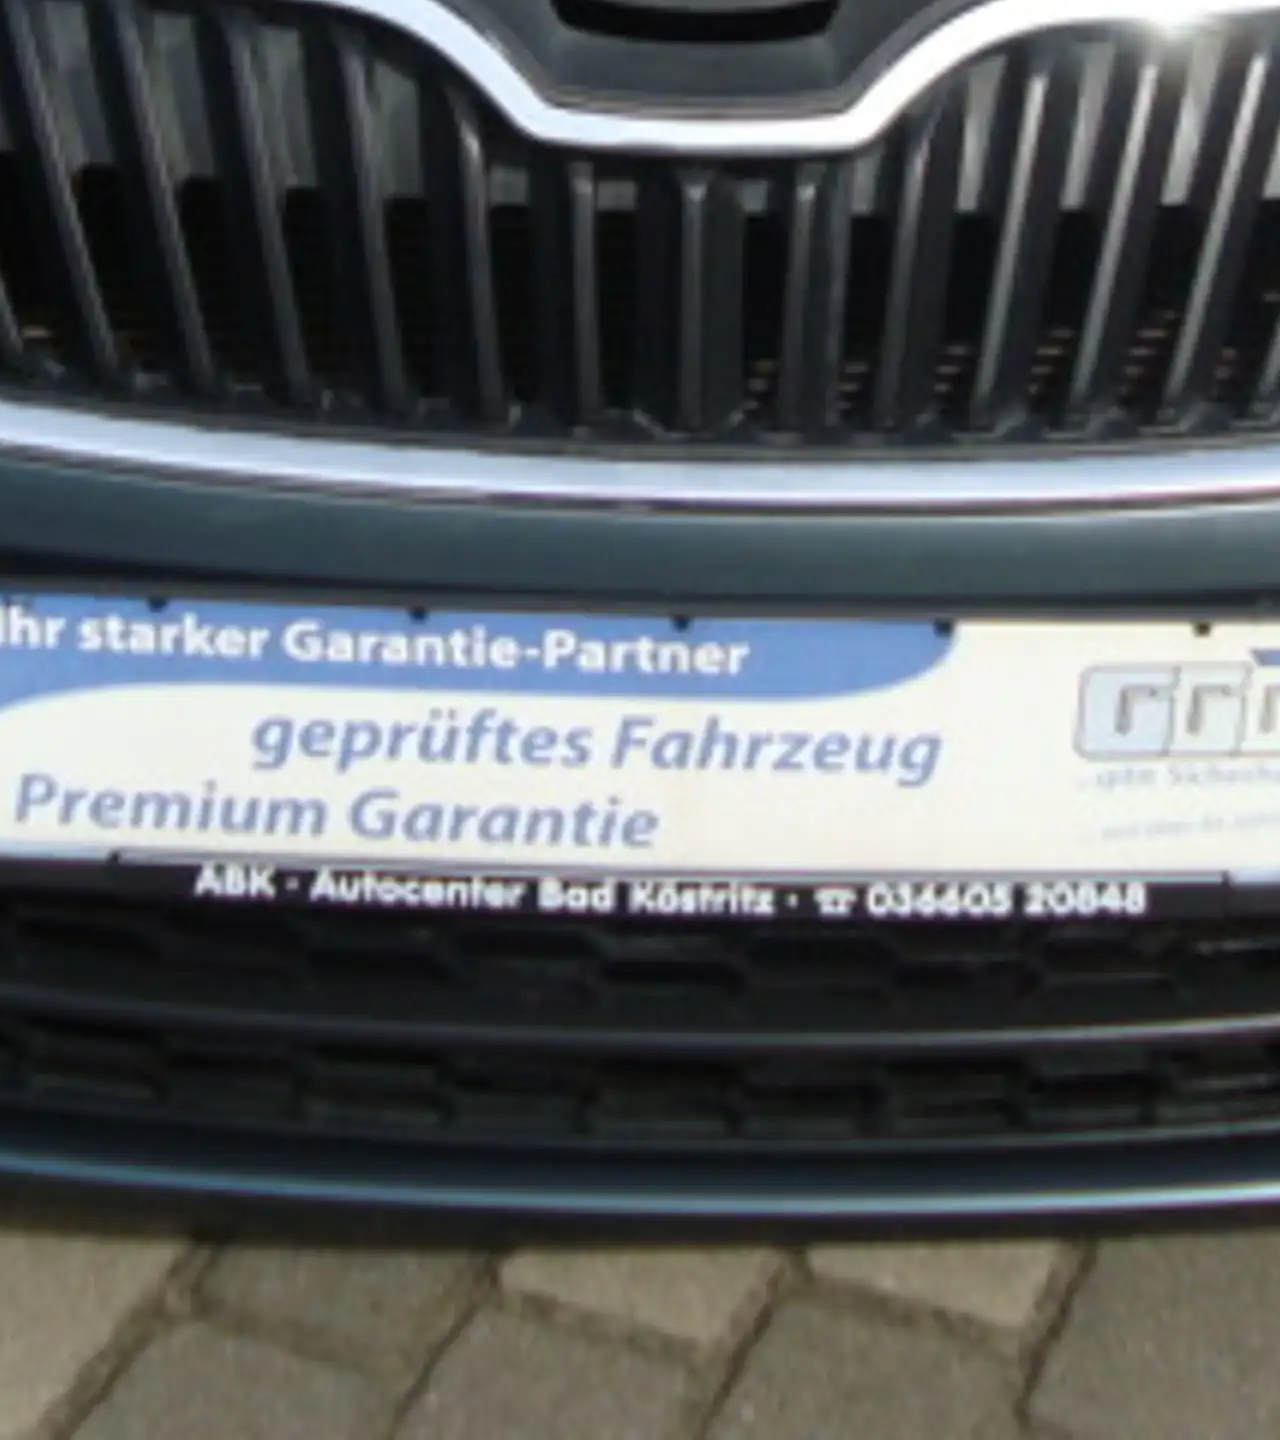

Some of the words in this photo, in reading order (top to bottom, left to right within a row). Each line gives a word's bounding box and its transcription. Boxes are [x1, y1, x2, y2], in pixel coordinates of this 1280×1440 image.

[77, 612, 271, 660] starker
[281, 620, 752, 679] Garantie-Partner
[251, 707, 593, 776] geprüftes
[610, 714, 944, 790] Fahrzeug
[14, 771, 328, 840] Premium
[348, 788, 661, 850] Garantie
[194, 862, 278, 897] ABK
[309, 868, 527, 911] Autocenter
[537, 876, 615, 914] Bad
[628, 877, 776, 915] Köstritz
[865, 881, 1013, 917] 036605
[1023, 881, 1147, 917] 20848
